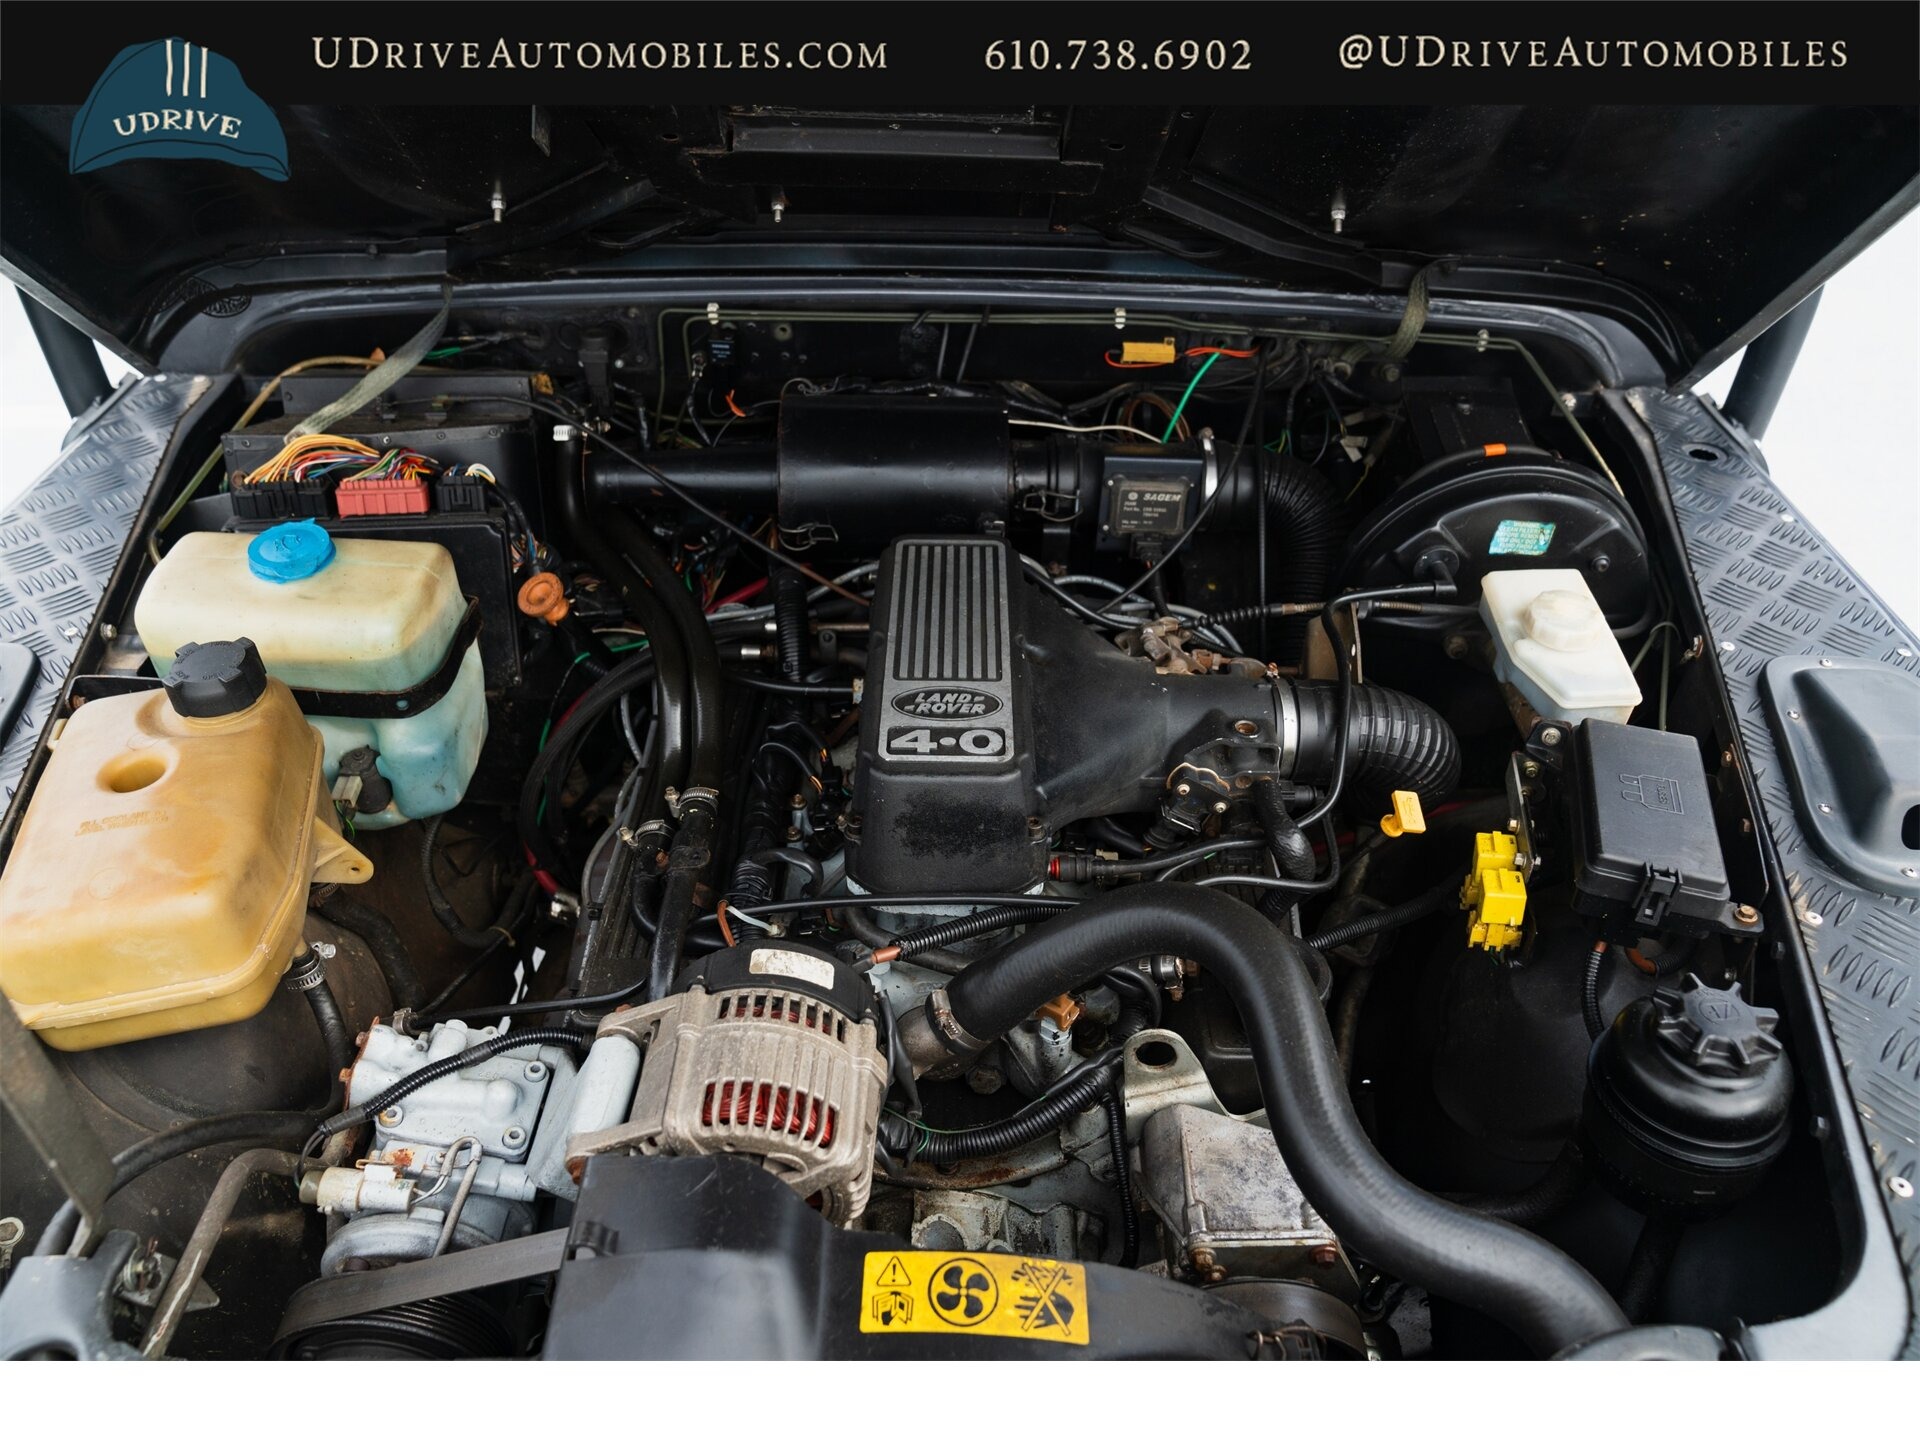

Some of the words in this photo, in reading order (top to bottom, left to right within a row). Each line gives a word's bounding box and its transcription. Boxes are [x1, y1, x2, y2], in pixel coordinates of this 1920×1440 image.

[1143, 492, 1182, 502] SAGEM
[915, 692, 971, 703] LAND
[915, 703, 986, 715] ROVER
